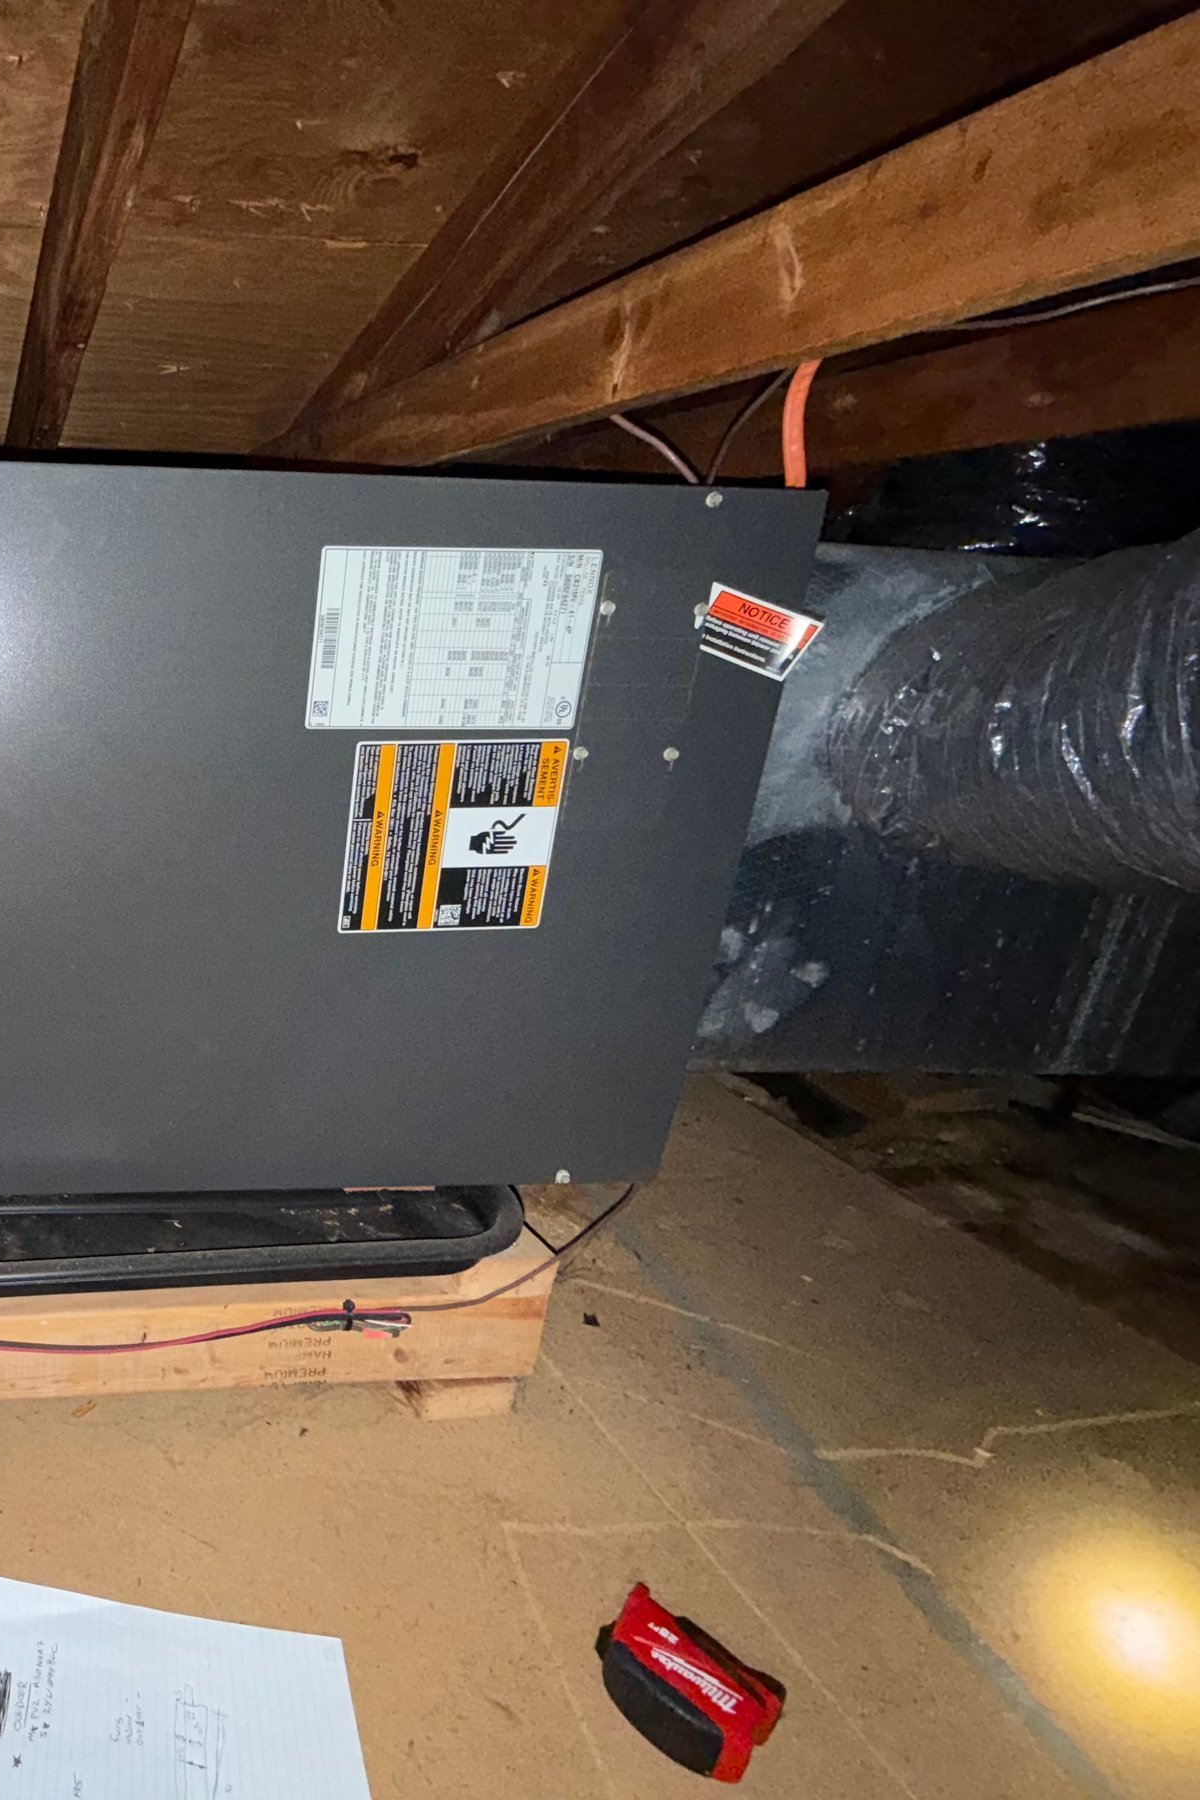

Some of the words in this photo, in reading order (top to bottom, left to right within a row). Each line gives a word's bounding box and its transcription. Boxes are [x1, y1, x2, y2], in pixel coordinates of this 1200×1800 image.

[566, 554, 574, 566] S/N
[575, 554, 583, 568] M/N
[586, 557, 598, 594] LENNOX
[738, 602, 791, 629] NOTICE
[536, 758, 550, 800] SEMENT
[546, 758, 560, 803] AVERTIS-
[370, 820, 383, 866] WARNING
[427, 819, 441, 865] WARNING
[524, 879, 538, 923] WARNING
[263, 1367, 326, 1379] PREMIUM
[650, 1649, 737, 1714] Milwaukee
